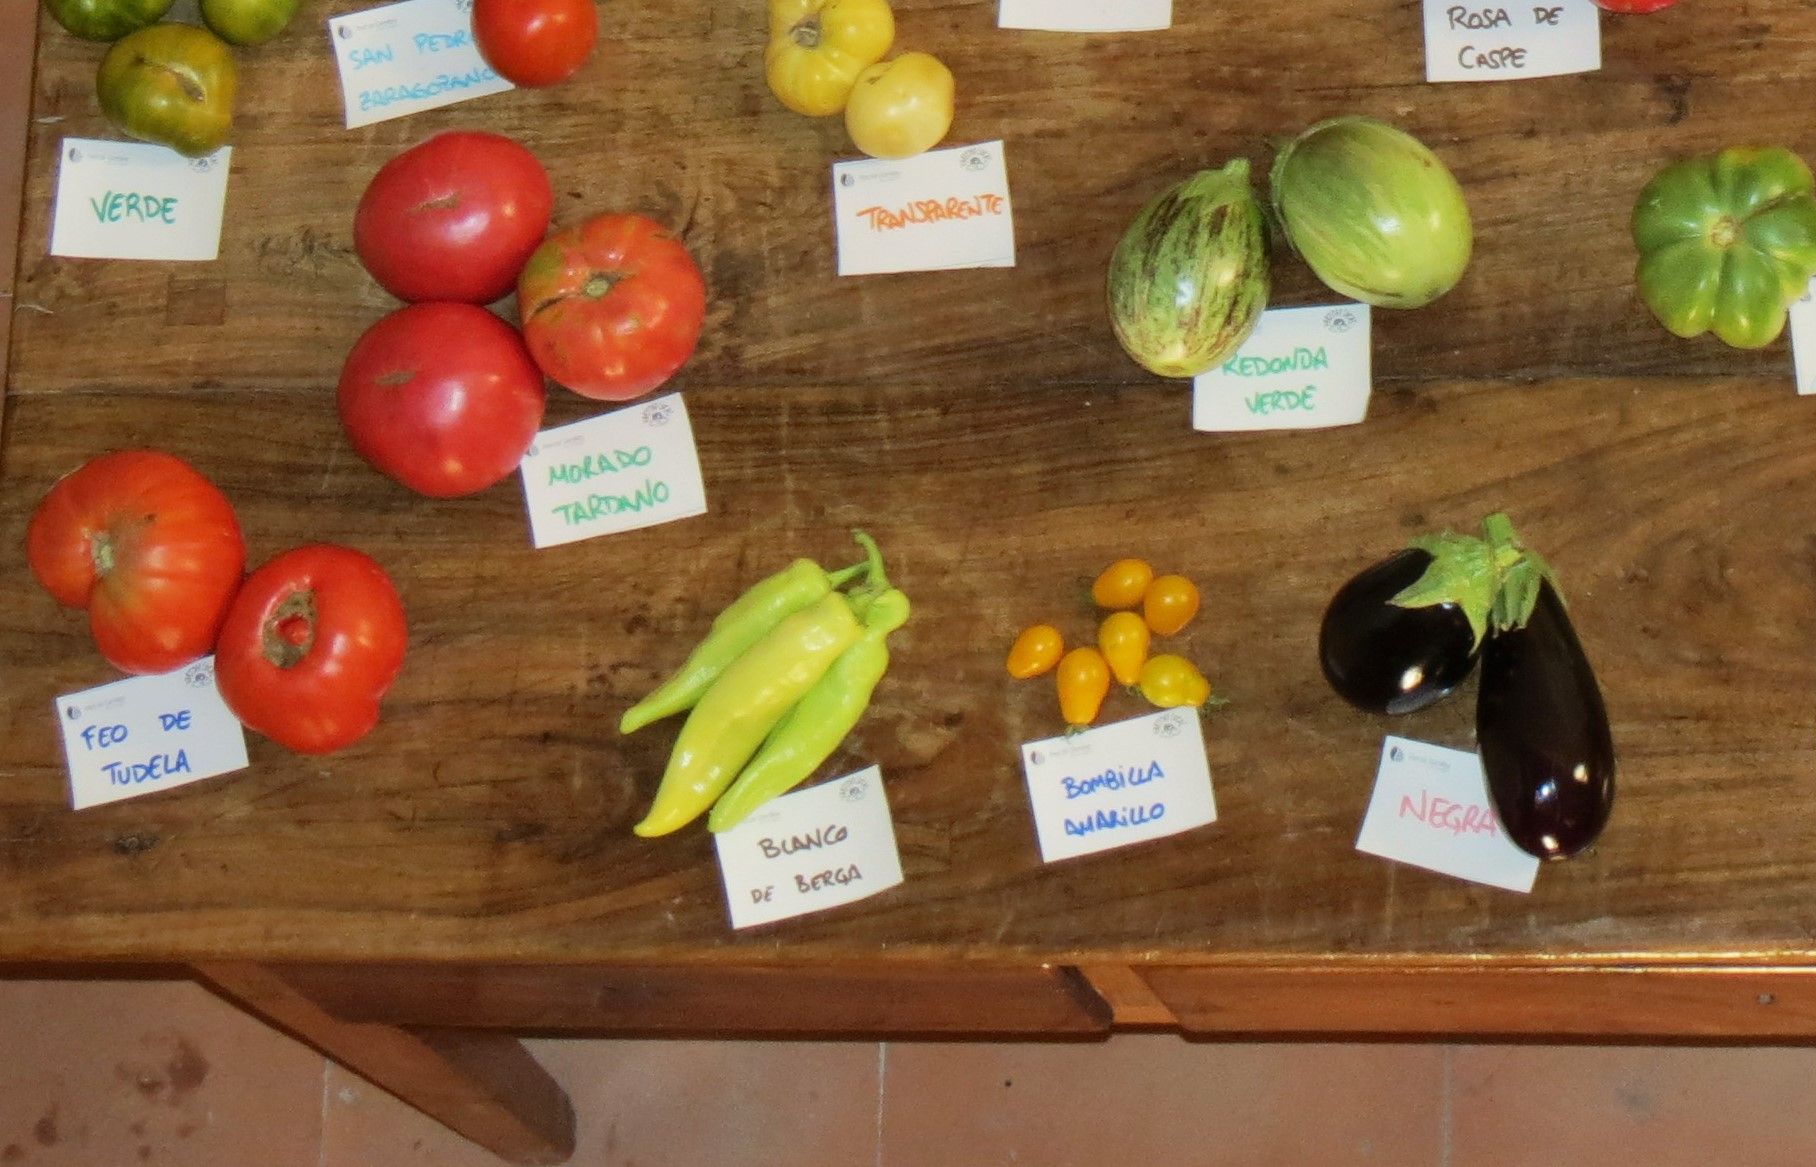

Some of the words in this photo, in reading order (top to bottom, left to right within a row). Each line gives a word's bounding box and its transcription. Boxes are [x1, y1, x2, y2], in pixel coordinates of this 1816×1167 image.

[1446, 6, 1510, 30] ROSA
[1534, 6, 1564, 27] DE
[348, 44, 394, 70] SAN
[413, 29, 474, 54] PEDR
[1458, 46, 1528, 70] CASPE
[358, 66, 498, 111] ZARAGOZANO
[90, 190, 179, 225] VERDE
[856, 194, 1005, 232] TRANSPARENTE
[1221, 346, 1329, 379] REDONDA
[1244, 385, 1318, 417] VERDE
[548, 446, 652, 487] MORADO
[551, 478, 671, 527] TARDANO
[80, 725, 128, 752] FEO
[159, 710, 192, 732] DE
[101, 749, 191, 788] TUDELA
[1061, 759, 1165, 801] BOMBILLA
[1064, 801, 1166, 837] AMARILLO
[1398, 789, 1498, 839] NEGRA
[758, 824, 850, 858] BLANCO
[750, 886, 775, 904] DE
[795, 866, 863, 894] BERGA
